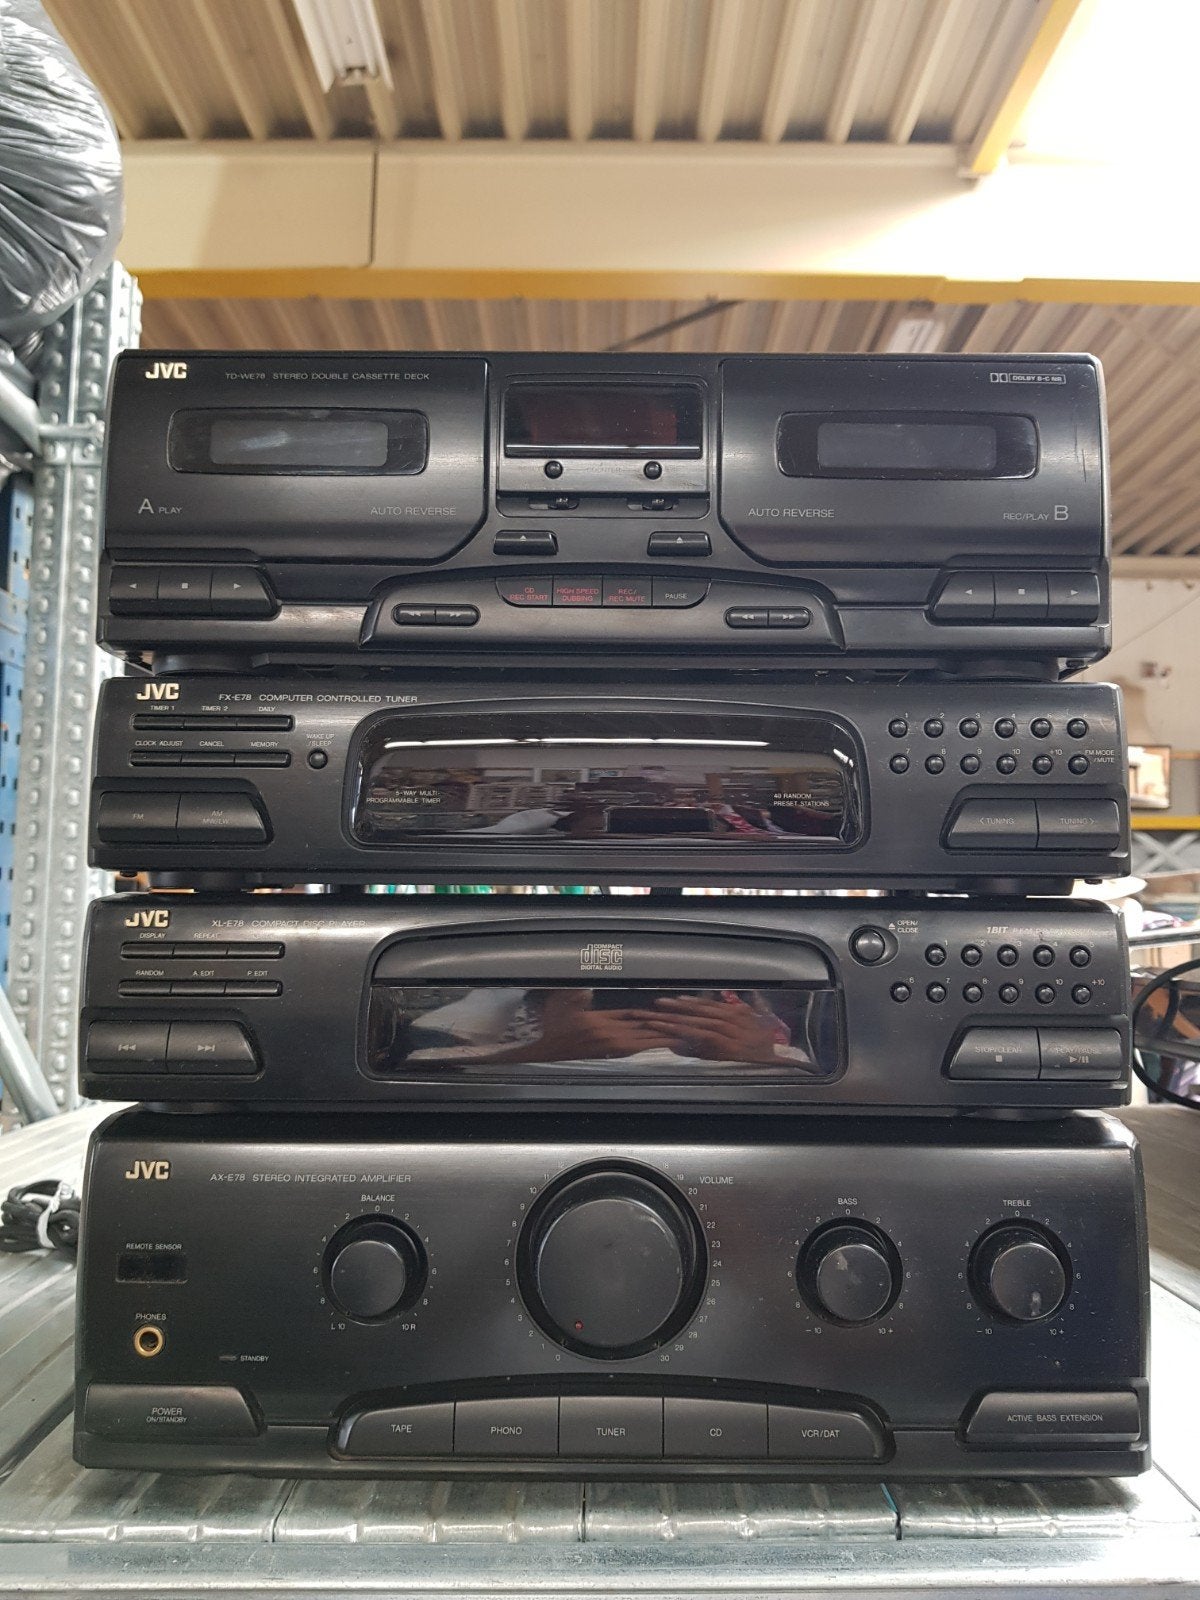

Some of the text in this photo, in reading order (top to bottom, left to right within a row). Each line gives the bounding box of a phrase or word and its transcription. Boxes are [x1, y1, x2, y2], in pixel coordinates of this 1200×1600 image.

[145, 362, 187, 379] JVC
[225, 373, 430, 381] TD-WE78 STEREO DOUBLE CASSETTE DECK
[138, 498, 183, 515] A PLAY
[370, 506, 456, 516] AUTO REVERSE
[748, 508, 835, 518] AUTO REVERSE
[1003, 505, 1069, 521] REC/PLAY B
[137, 683, 180, 700] JVC
[219, 693, 418, 703] FX-E78 COMPUTER CONTROLLED TUNER
[199, 740, 225, 748] CANCEL
[250, 740, 279, 748] MEMORY
[124, 910, 170, 928] JVC
[211, 920, 244, 928] XL-E78
[251, 920, 299, 928] COMPACT
[986, 926, 1009, 934] 1BIT
[126, 1160, 169, 1180] JVC
[210, 1173, 411, 1183] AX-E78 STEREO INTEGRATED AMPLIFIER
[700, 1176, 734, 1184] VOLUME
[688, 1187, 698, 1195] 20
[361, 1194, 395, 1202] BALANCE
[700, 1203, 708, 1211] 21
[135, 1313, 167, 1321] PHONES
[151, 1407, 183, 1416] POWER
[146, 1416, 188, 1424] ON/STANDBY
[1007, 1413, 1103, 1422] ACTIVE BASS EXTENSION
[391, 1425, 413, 1433] TAPE
[490, 1426, 523, 1436] PHONO
[596, 1427, 626, 1437] TUNER
[709, 1428, 723, 1437] CD
[800, 1429, 841, 1439] VCR/DAT
